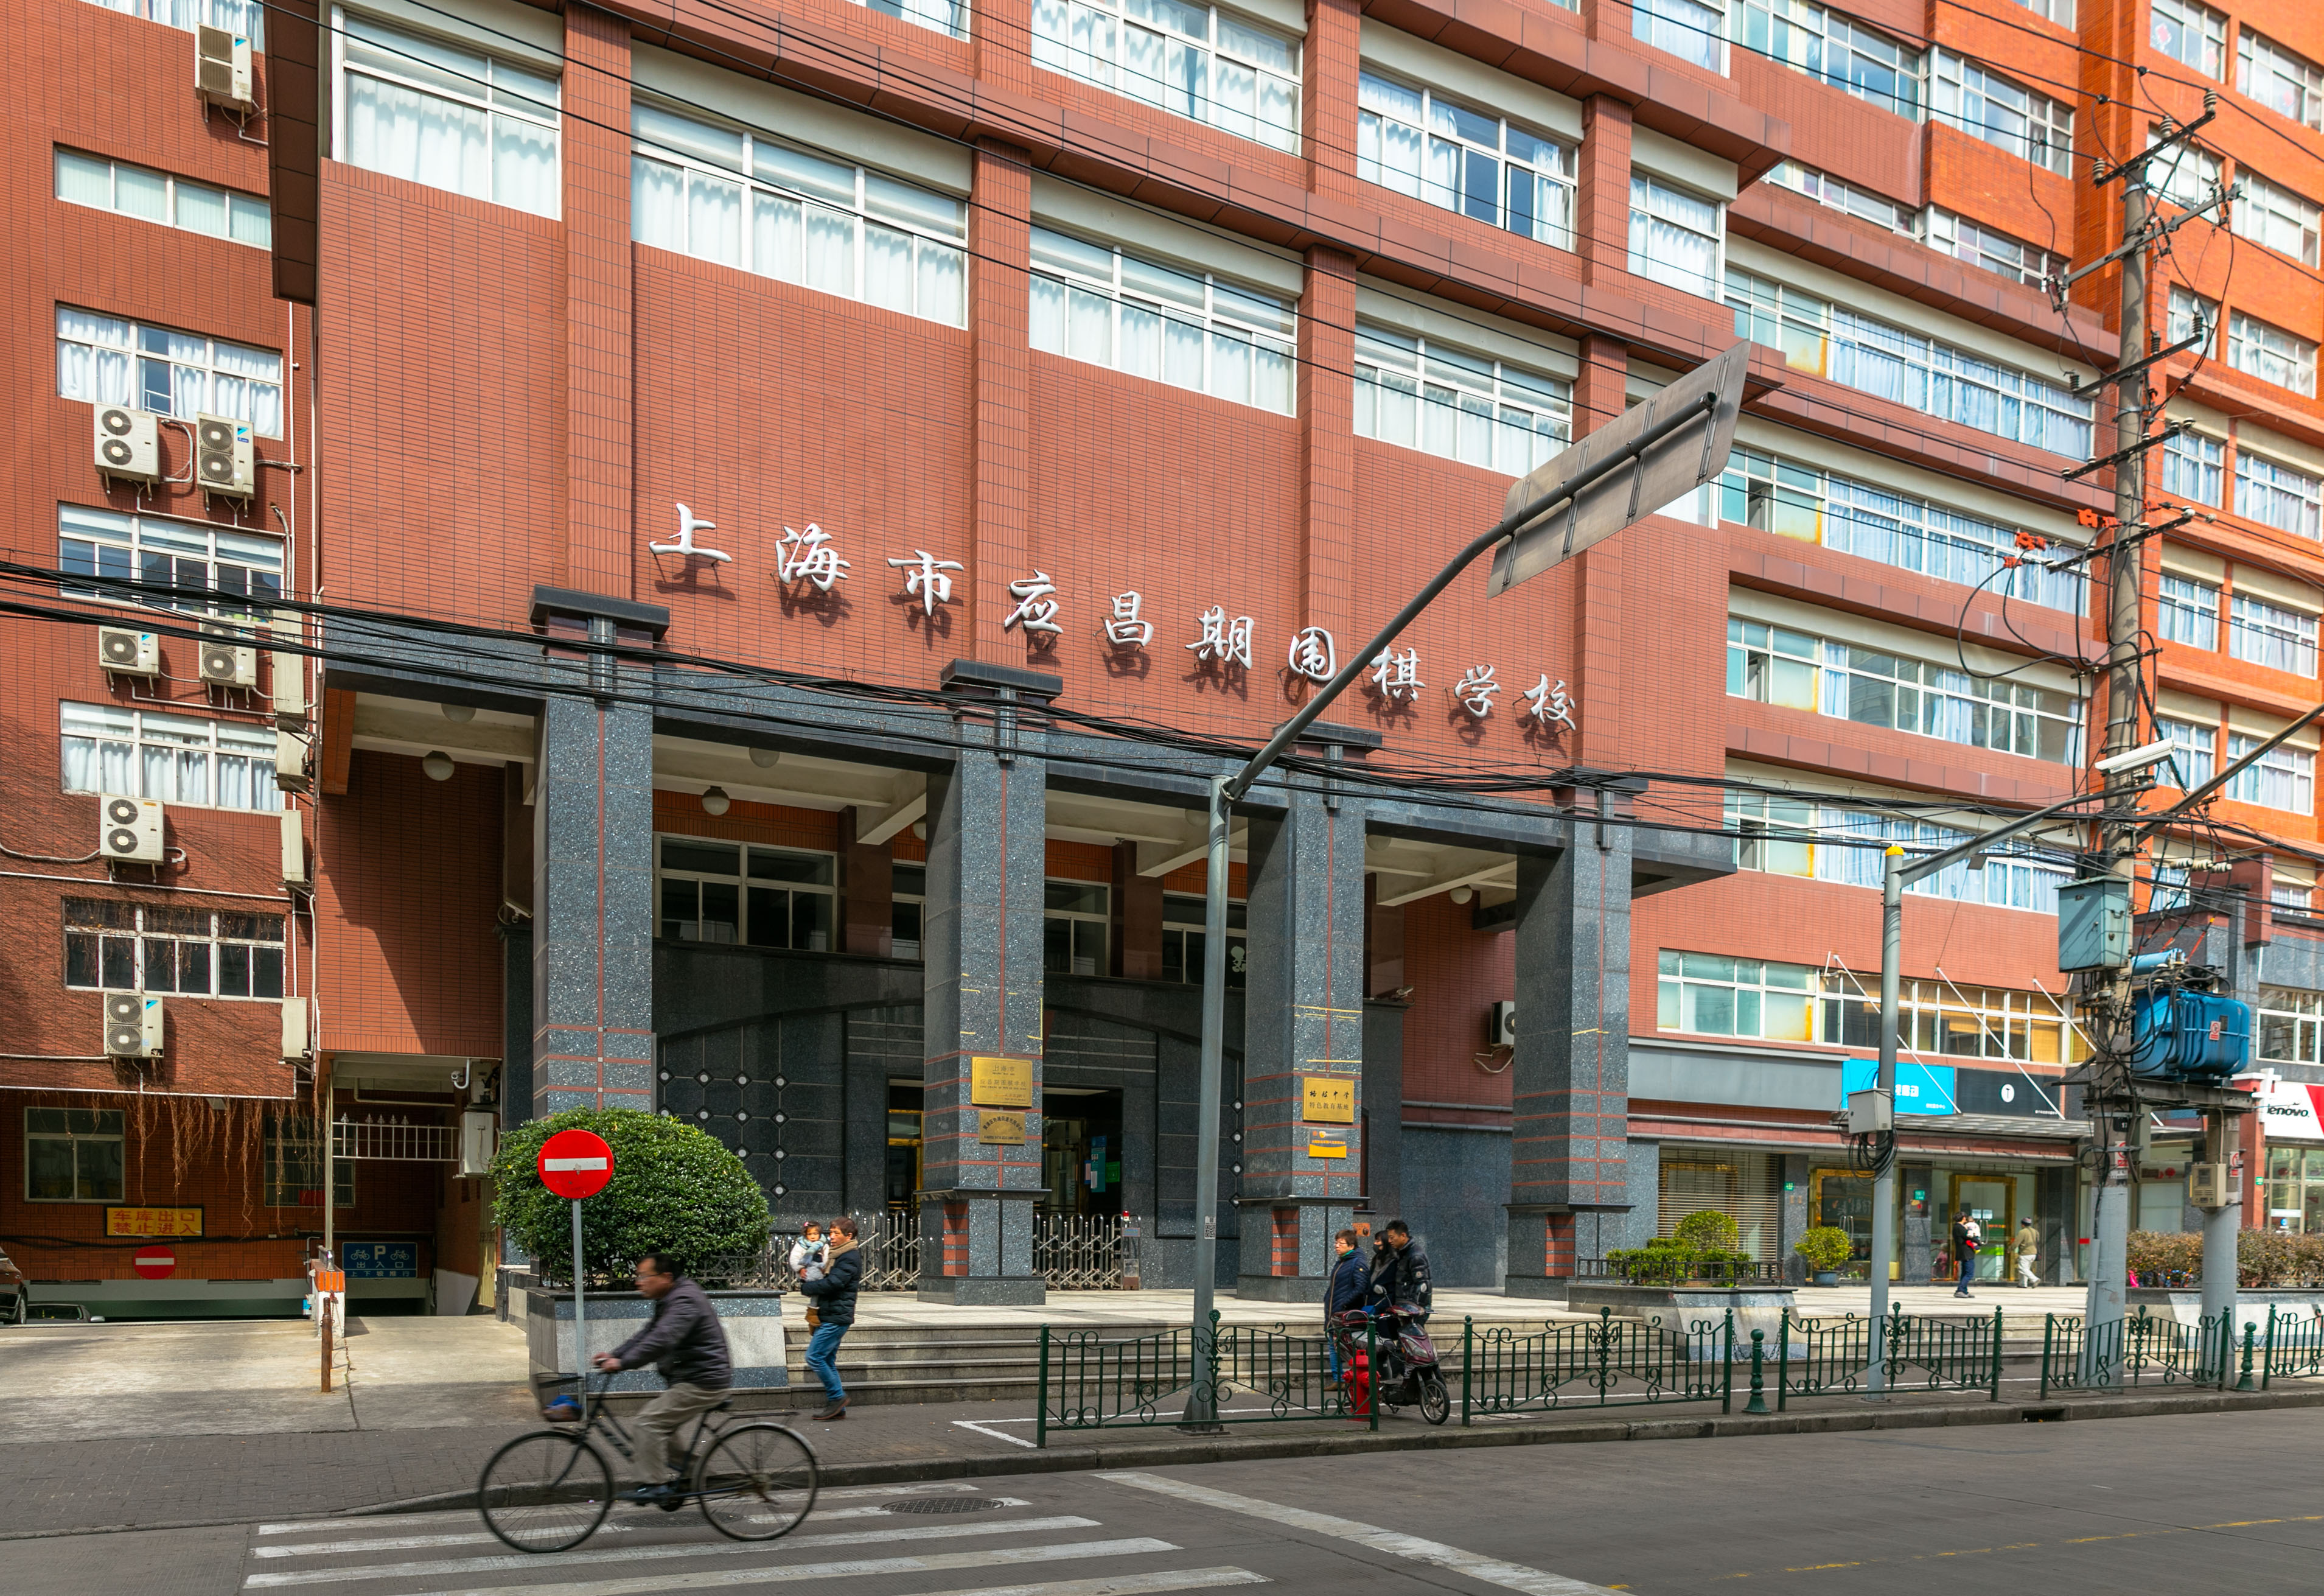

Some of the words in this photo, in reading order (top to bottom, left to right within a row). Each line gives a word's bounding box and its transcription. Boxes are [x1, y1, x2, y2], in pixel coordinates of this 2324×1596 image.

[649, 502, 1576, 730] 上海市应昌期围棋学校
[1309, 1101, 1349, 1110] 特色教育基地
[2267, 1104, 2309, 1117] lenovo
[113, 1209, 195, 1222] 车库出口
[113, 1222, 196, 1234] 禁止进入
[374, 1245, 386, 1260] P
